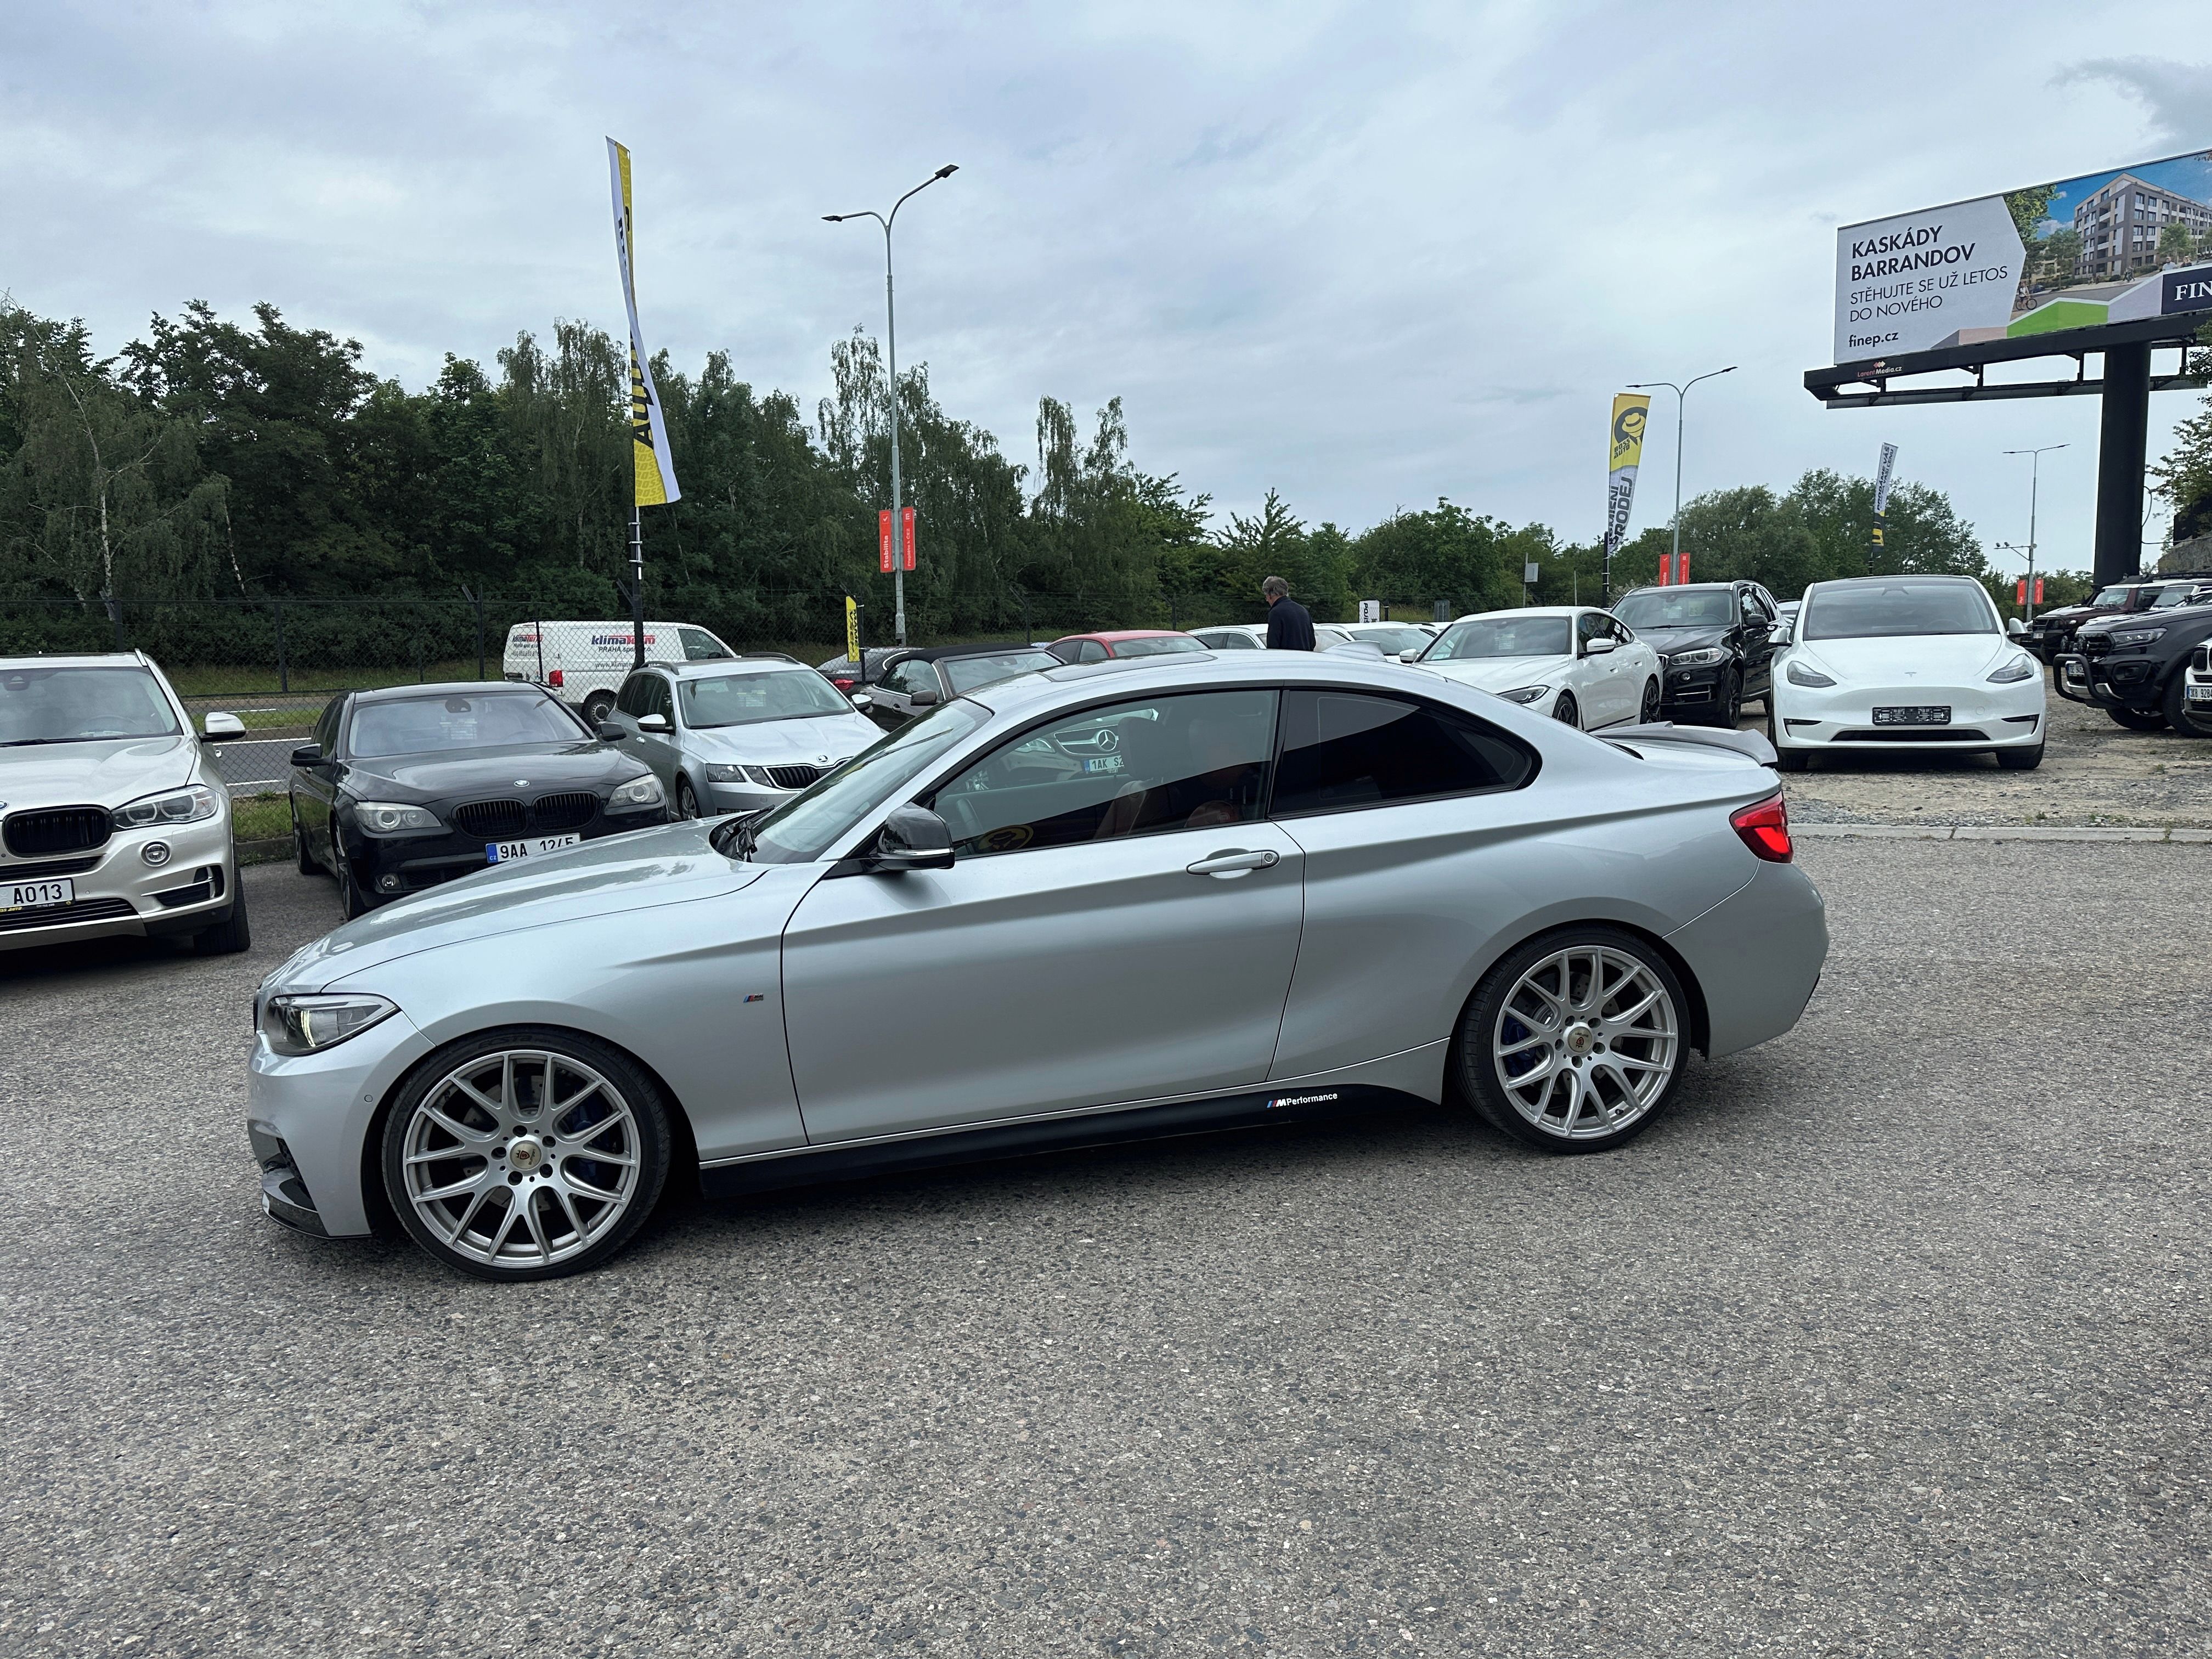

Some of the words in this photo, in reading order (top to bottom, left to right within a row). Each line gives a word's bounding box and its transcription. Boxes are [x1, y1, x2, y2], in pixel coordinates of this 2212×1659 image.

[1852, 225, 1943, 259] KASKÁDY
[1851, 243, 1976, 281] BARRANDOV
[1850, 282, 1914, 304] STĚHUJTE
[1918, 278, 1934, 292] SE
[1939, 271, 1959, 289] UŽ
[1963, 266, 2007, 285] LETOS
[2174, 280, 2212, 301] FIN
[1850, 308, 1872, 322] DO
[1876, 296, 1943, 318] NOVÉHO
[1849, 332, 1899, 347] finep.cz
[1613, 444, 1630, 459] AUTO
[1615, 438, 1630, 453] BOSS
[1092, 759, 1108, 770] 1AK
[500, 843, 528, 859] 9AA
[14, 884, 62, 904] A013
[1286, 1092, 1338, 1106] Performance
